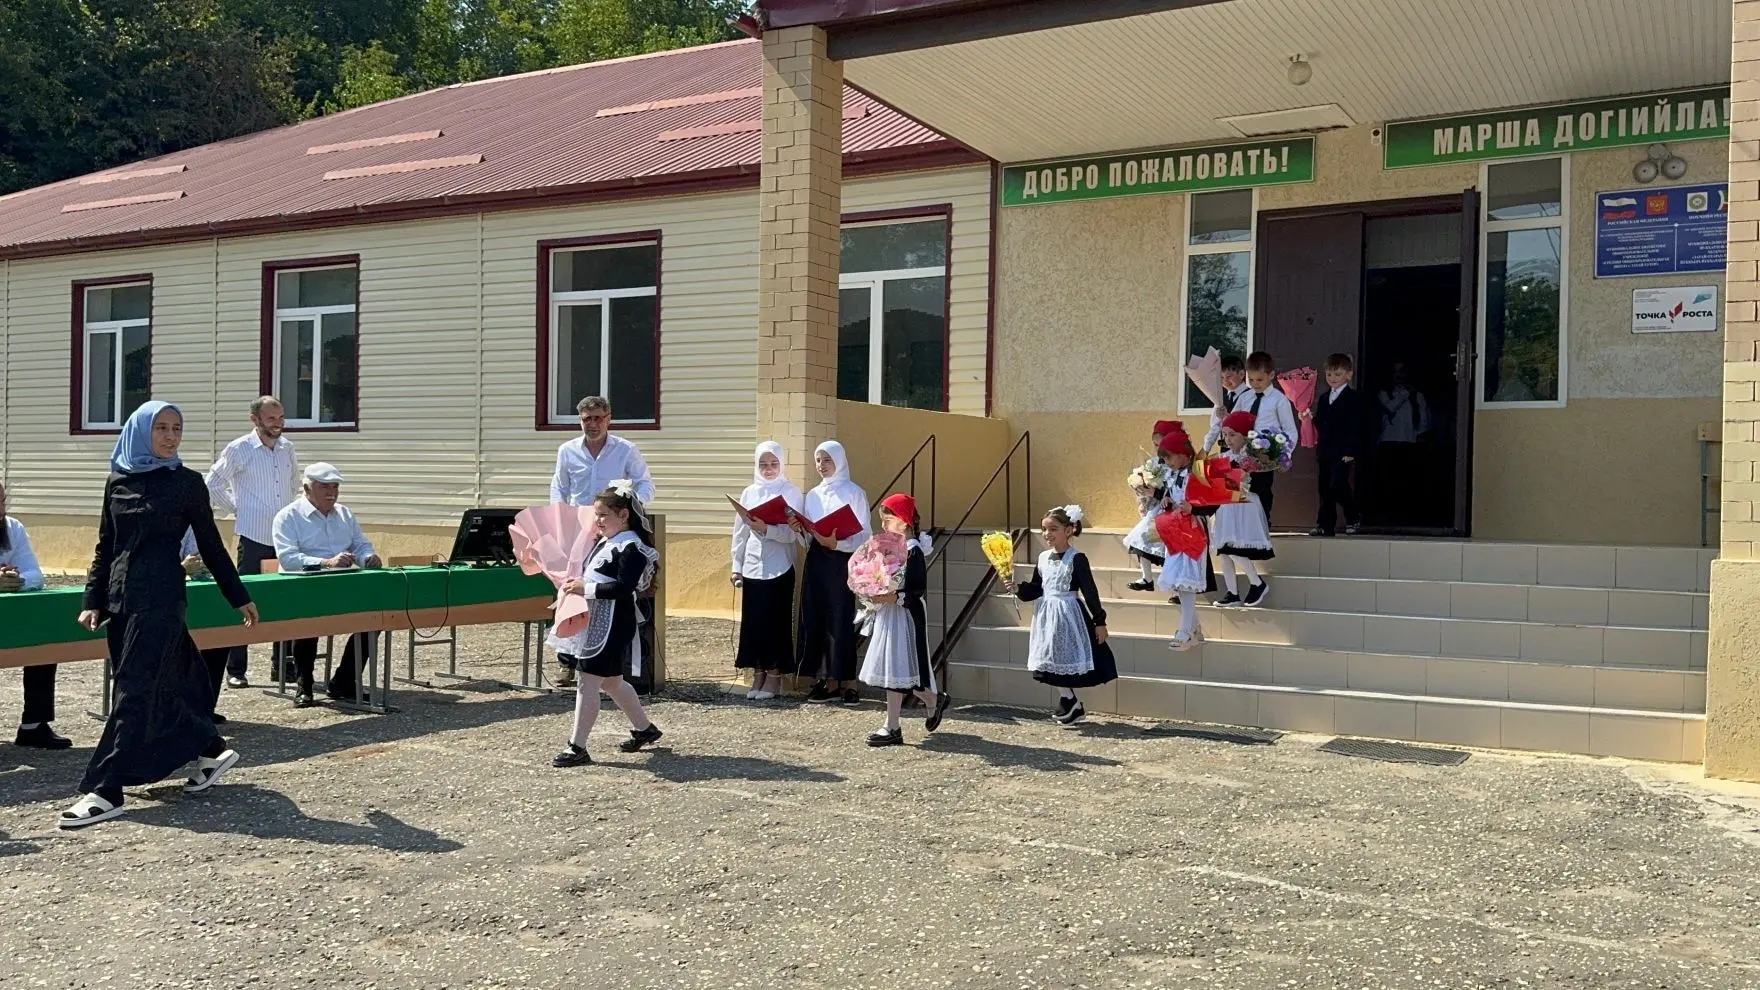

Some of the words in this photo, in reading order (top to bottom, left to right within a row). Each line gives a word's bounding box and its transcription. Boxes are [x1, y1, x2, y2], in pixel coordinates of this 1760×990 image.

[1433, 118, 1541, 156] МАРША
[1022, 164, 1099, 199] ДОБРО
[1109, 147, 1290, 188] ПОЖАЛОВАТЬ!
[1635, 312, 1667, 320] ТОЧКА
[1682, 310, 1713, 318] РОСТА
